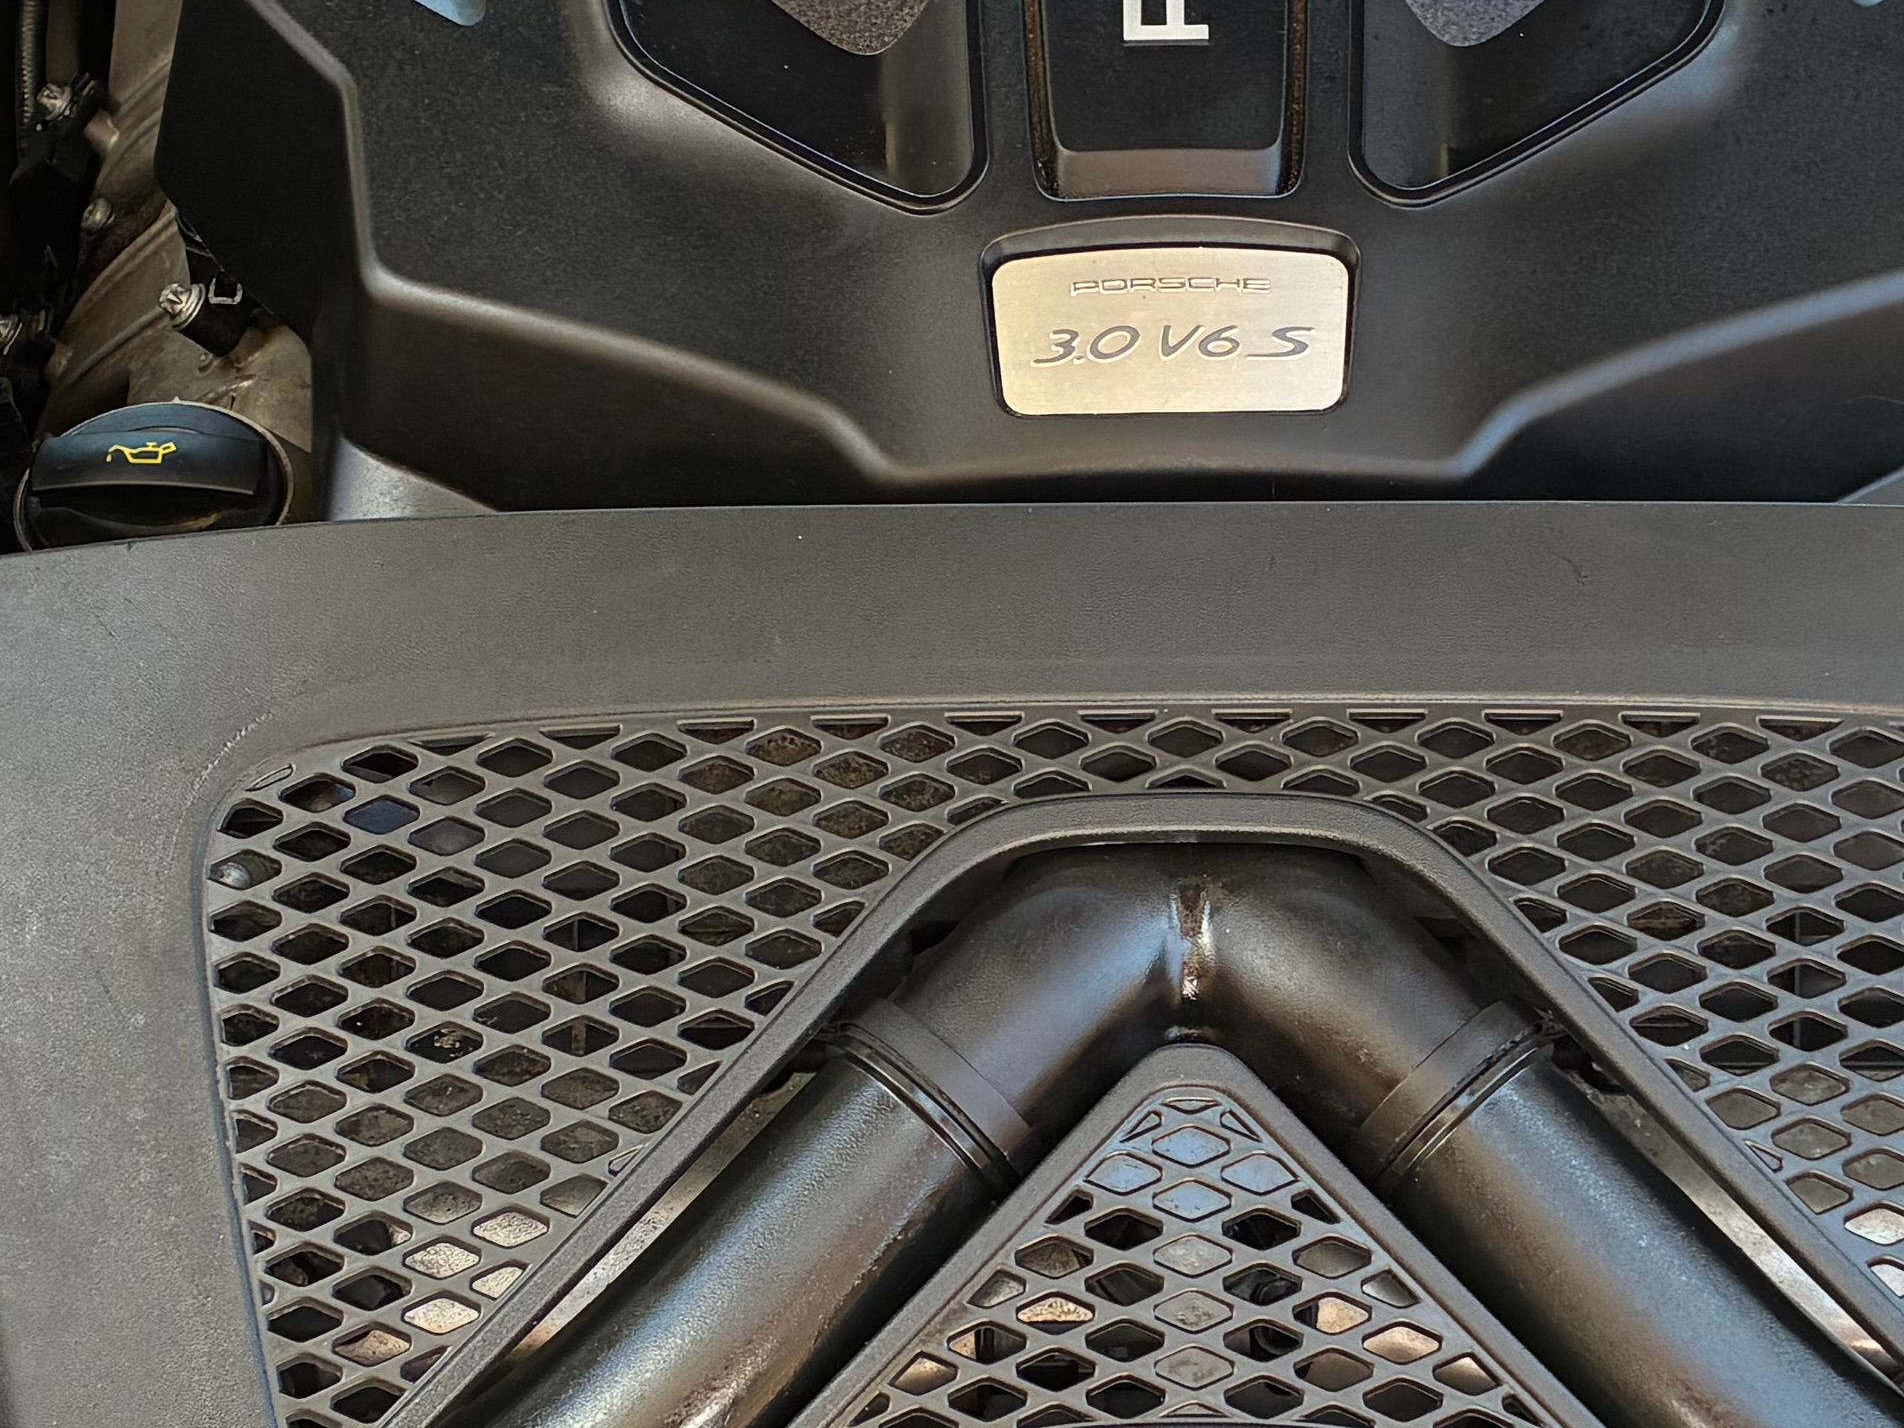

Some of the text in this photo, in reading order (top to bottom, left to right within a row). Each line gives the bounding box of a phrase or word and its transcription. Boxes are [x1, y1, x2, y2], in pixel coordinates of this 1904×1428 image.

[1070, 276, 1271, 297] PORSCHE
[1030, 324, 1316, 369] 3.0 V6 S
